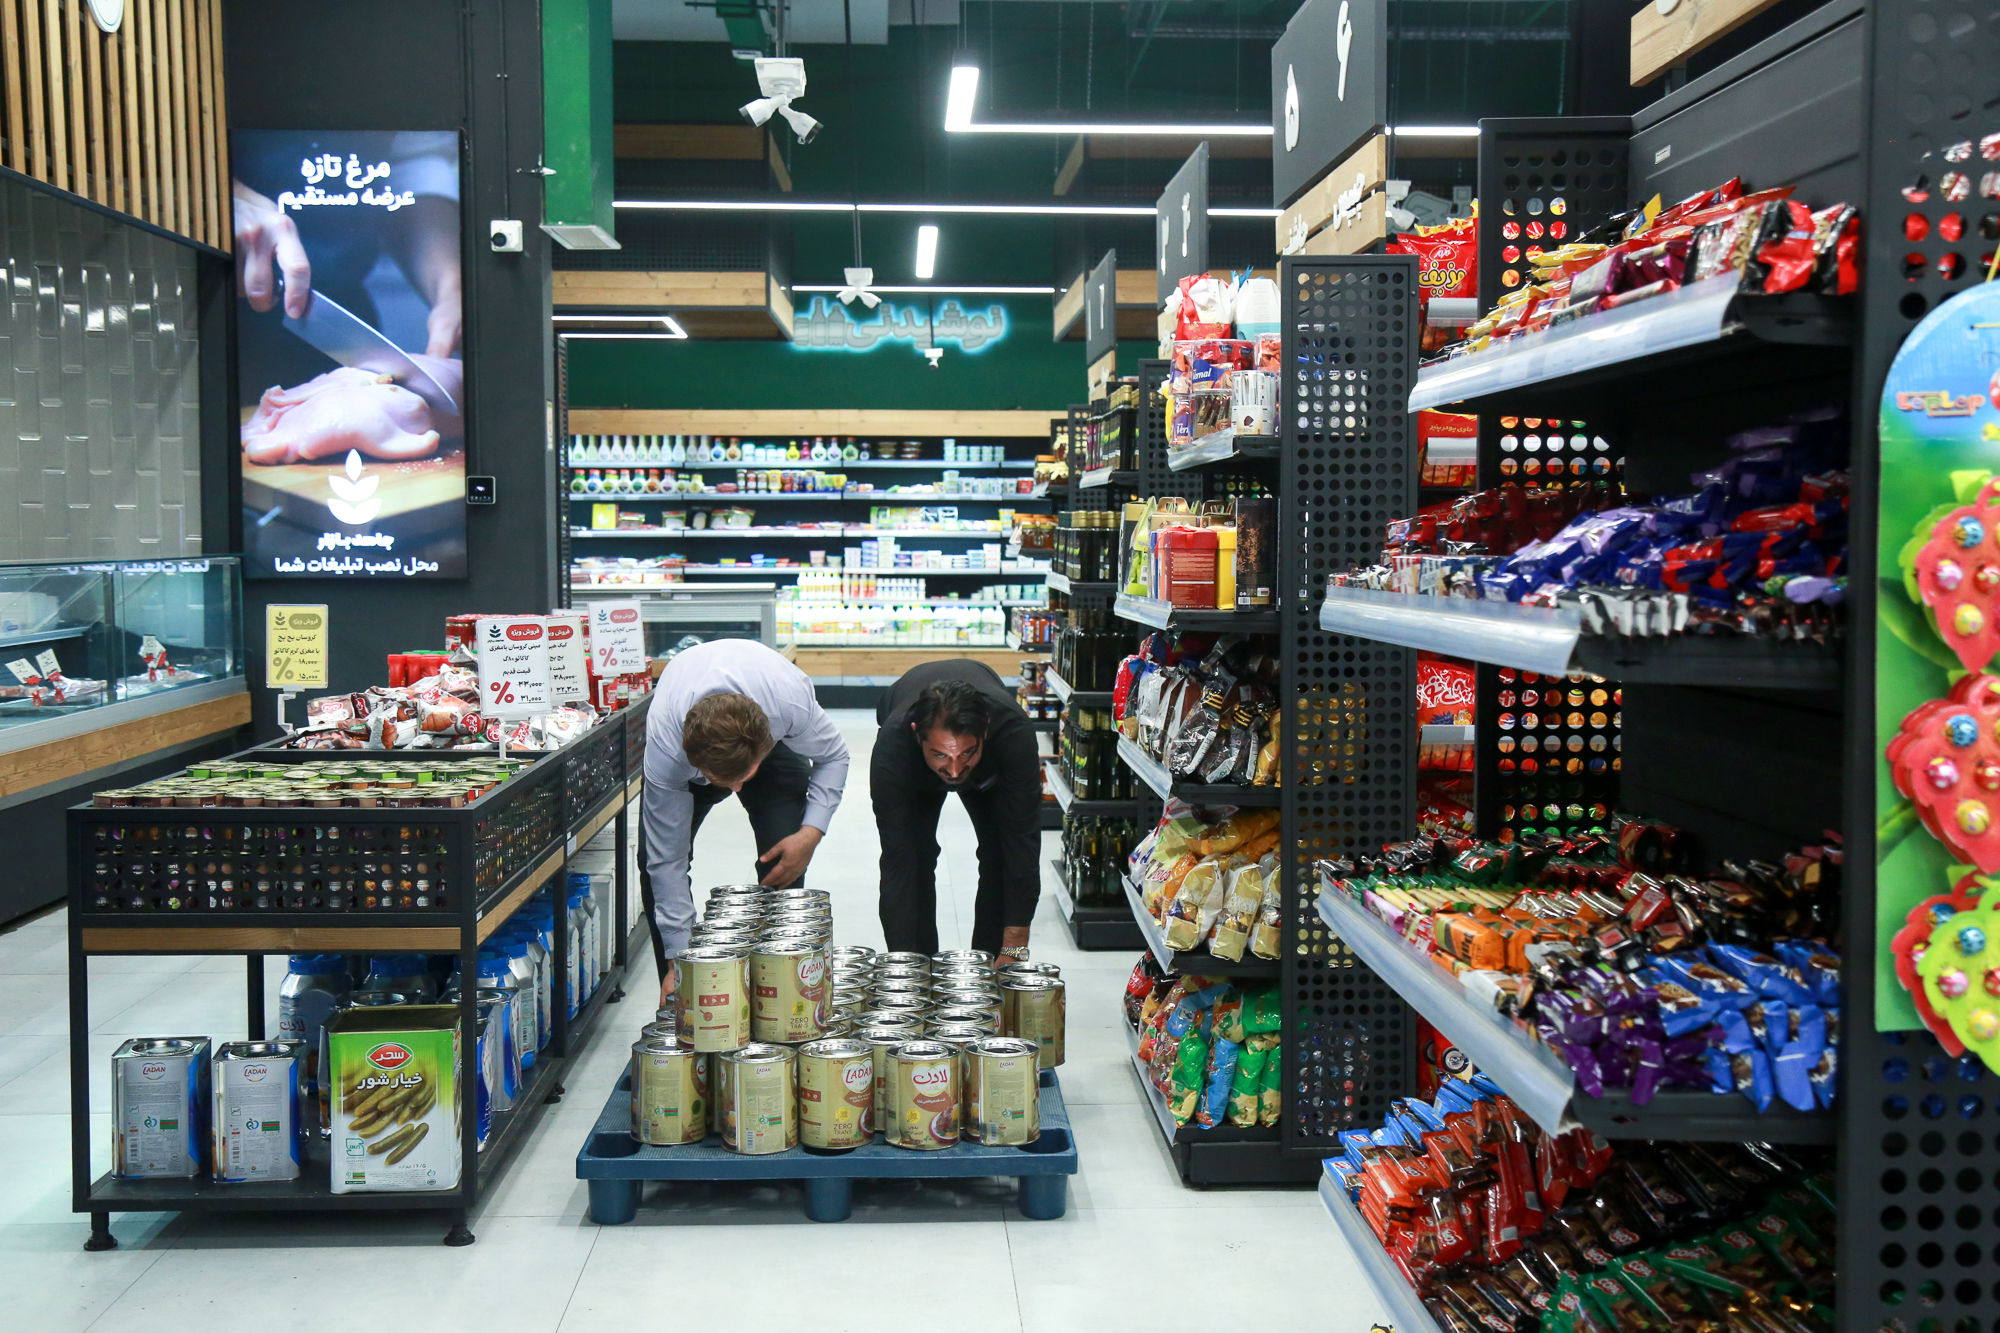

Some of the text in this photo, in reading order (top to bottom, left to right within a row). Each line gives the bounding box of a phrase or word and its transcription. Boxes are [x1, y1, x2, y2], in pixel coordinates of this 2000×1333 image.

[301, 154, 391, 188] مرغ تازه
[278, 186, 415, 214] عرضه مستقیم
[274, 556, 439, 576] محل نصب تبلیغات شما
[510, 627, 540, 637] فروش ویژه
[556, 627, 570, 636] فروش
[801, 960, 823, 979] LADAN
[375, 1051, 405, 1062] سحر
[142, 1065, 167, 1077] LADAN
[244, 1066, 268, 1079] LADAN
[846, 1066, 873, 1084] LADAN
[912, 1068, 948, 1085] لادن
